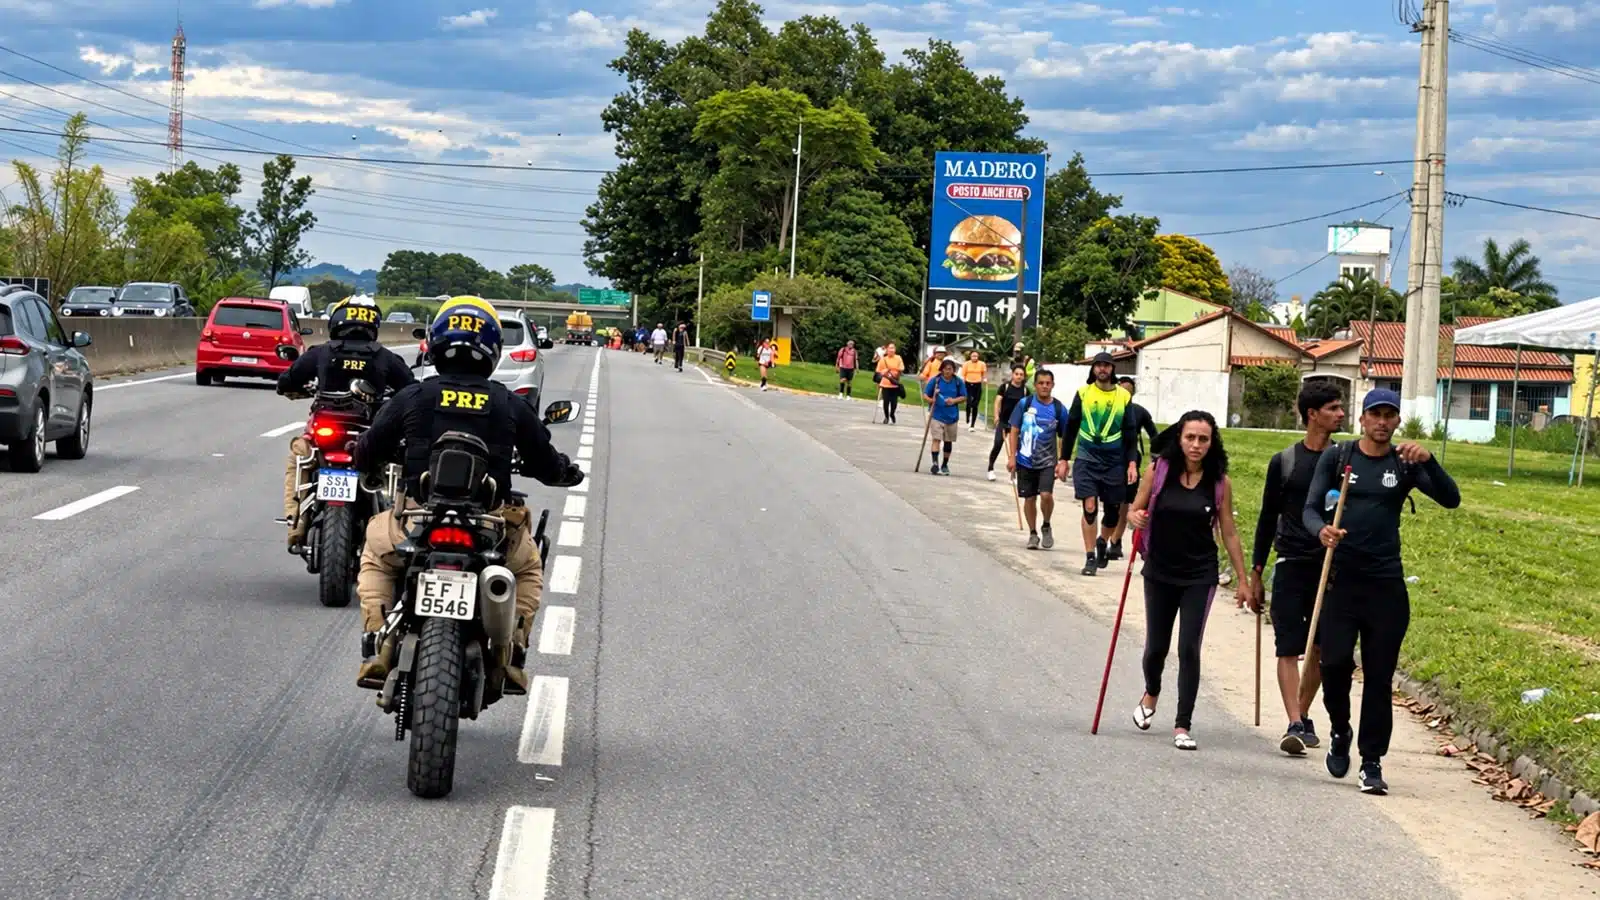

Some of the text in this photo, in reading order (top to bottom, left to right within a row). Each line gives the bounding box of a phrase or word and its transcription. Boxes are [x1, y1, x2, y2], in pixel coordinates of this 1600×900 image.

[944, 160, 1037, 180] MADERO
[953, 185, 980, 197] POSTO
[346, 307, 378, 323] PRF
[934, 299, 990, 323] 500 m
[447, 315, 486, 333] PRF
[342, 359, 367, 370] PRF
[440, 390, 489, 410] PRF
[326, 476, 349, 487] SSA
[323, 487, 351, 498] 8D31
[420, 598, 468, 616] 9546
